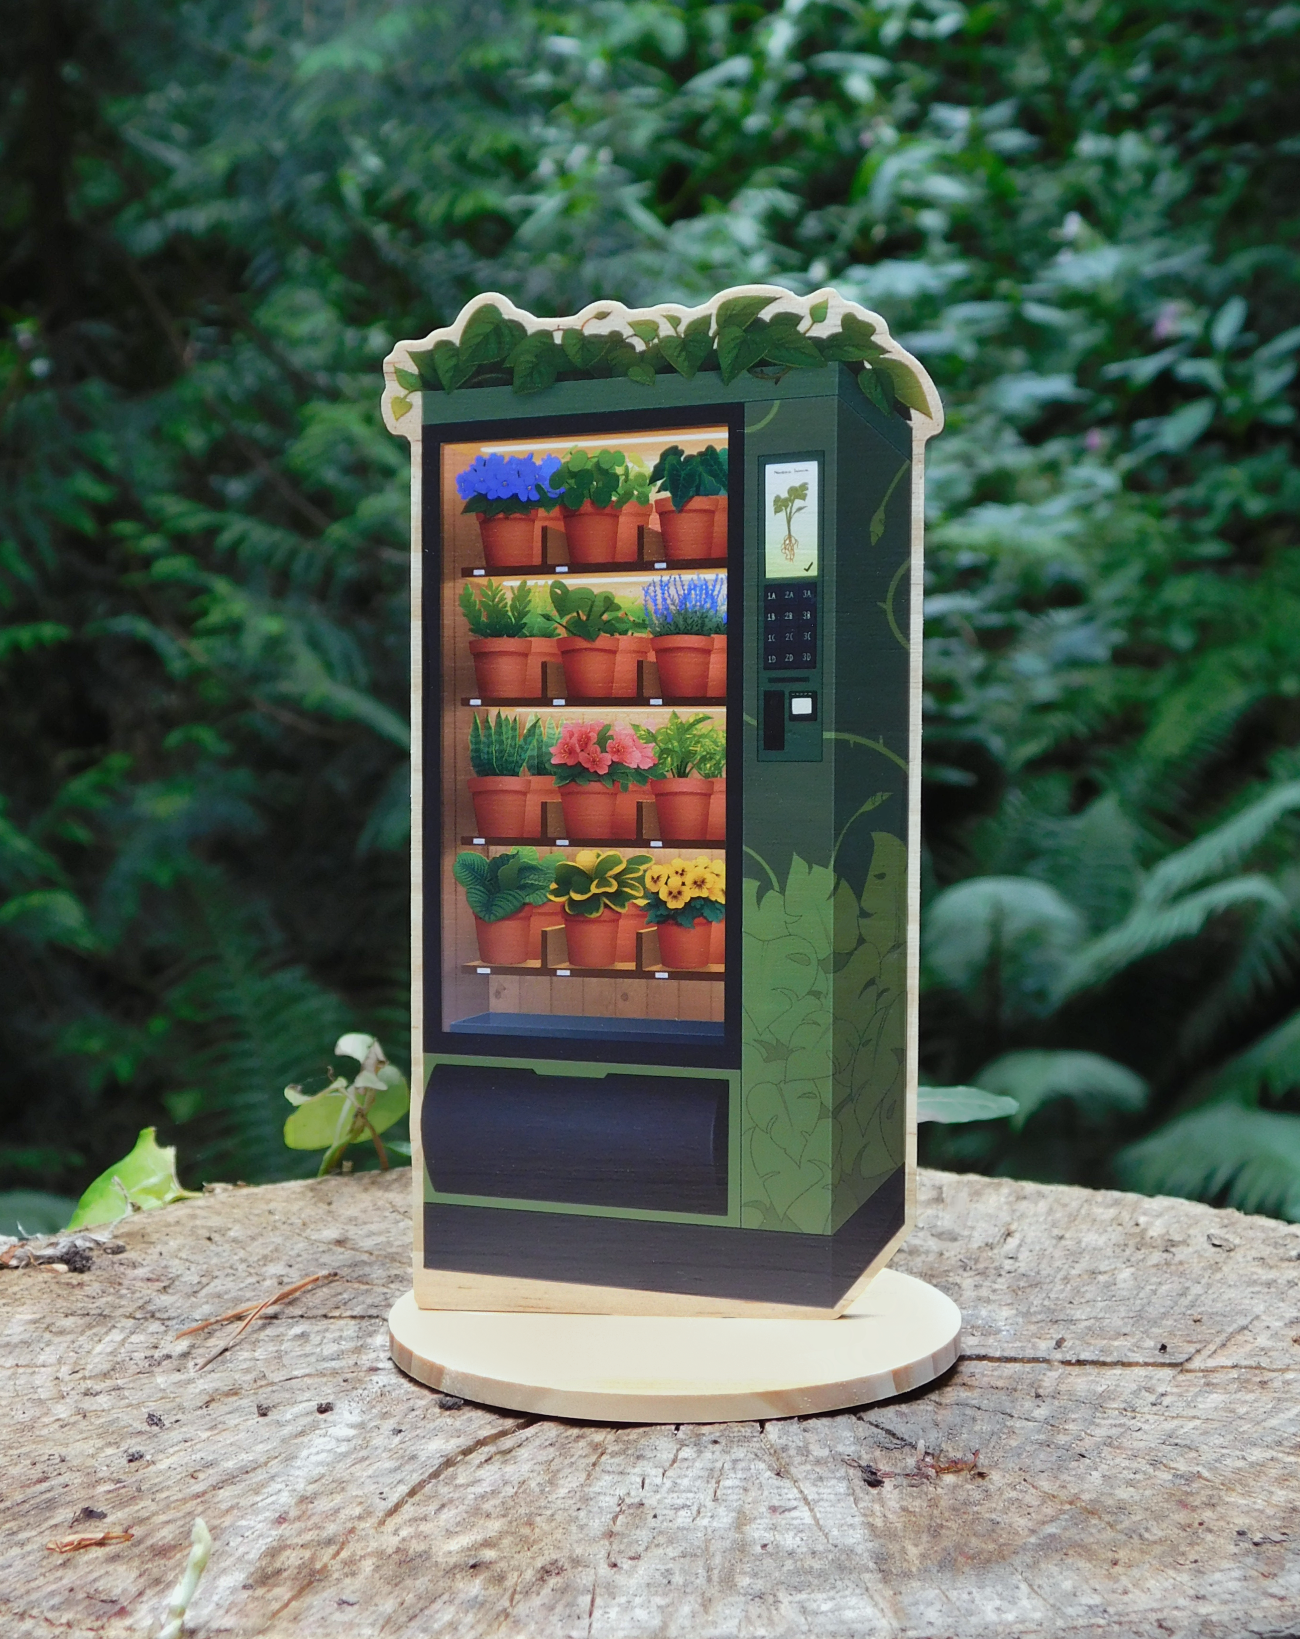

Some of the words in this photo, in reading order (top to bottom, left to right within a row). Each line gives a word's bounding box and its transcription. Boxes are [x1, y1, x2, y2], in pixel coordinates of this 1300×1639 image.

[767, 592, 776, 600] 1A
[803, 590, 811, 598] 3A
[768, 634, 776, 642] 1C
[785, 632, 793, 641] 2C
[803, 632, 811, 640] 3C
[768, 655, 776, 663] 1D
[785, 654, 794, 662] 2D
[802, 653, 811, 661] 3D
